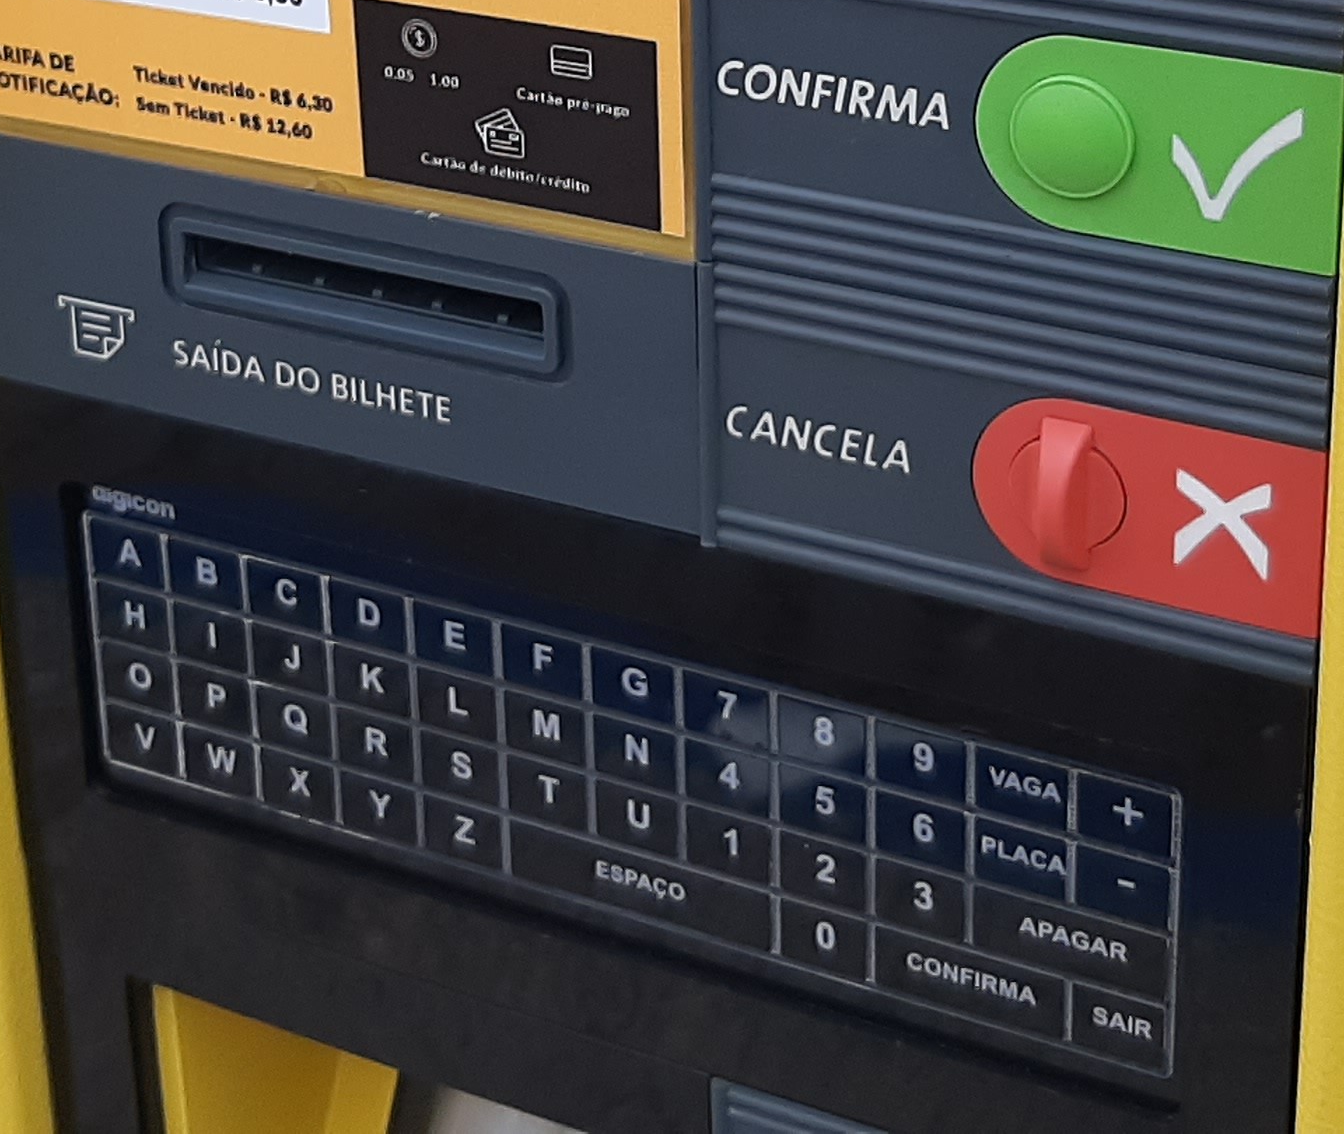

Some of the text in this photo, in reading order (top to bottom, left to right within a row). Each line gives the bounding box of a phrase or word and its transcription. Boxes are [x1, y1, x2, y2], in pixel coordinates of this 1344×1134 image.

[49, 53, 75, 73] DE
[133, 65, 185, 90] Ticket
[188, 75, 255, 101] Vencido
[270, 88, 293, 108] R$
[429, 72, 460, 89] 1.00
[516, 87, 563, 107] Cartão
[716, 60, 950, 131] CONFIRMA
[136, 97, 171, 116] Sem
[174, 101, 226, 126] Ticket
[240, 113, 262, 131] R$
[266, 118, 313, 140] 12,60
[420, 151, 466, 171] Cartão
[469, 159, 486, 174] de
[173, 339, 452, 424] SAÍDA DO BILHETE
[725, 405, 911, 474] CANCELA
[119, 539, 142, 568] A
[196, 557, 218, 586] B
[275, 578, 298, 606] C
[358, 597, 381, 627] D
[442, 620, 467, 651] E
[532, 642, 553, 670] F
[621, 667, 649, 698] G
[717, 690, 738, 719] 7
[813, 716, 835, 747] 8
[912, 742, 935, 772] 9
[988, 765, 1061, 803] VAGA
[124, 600, 146, 630] H
[208, 622, 217, 649] I
[283, 644, 301, 671] J
[360, 663, 384, 694] K
[447, 686, 469, 717] L
[531, 709, 561, 741] M
[624, 733, 650, 766] N
[718, 761, 740, 790] 4
[814, 785, 836, 816] 5
[912, 813, 935, 843] 6
[980, 835, 1067, 876] PLACA
[129, 663, 1129, 963] O P Q R S T U 1 2 3 APAGAR
[134, 723, 1153, 1040] V W X Y Z ESPAÇO 0 CONFIRMA SAIR
